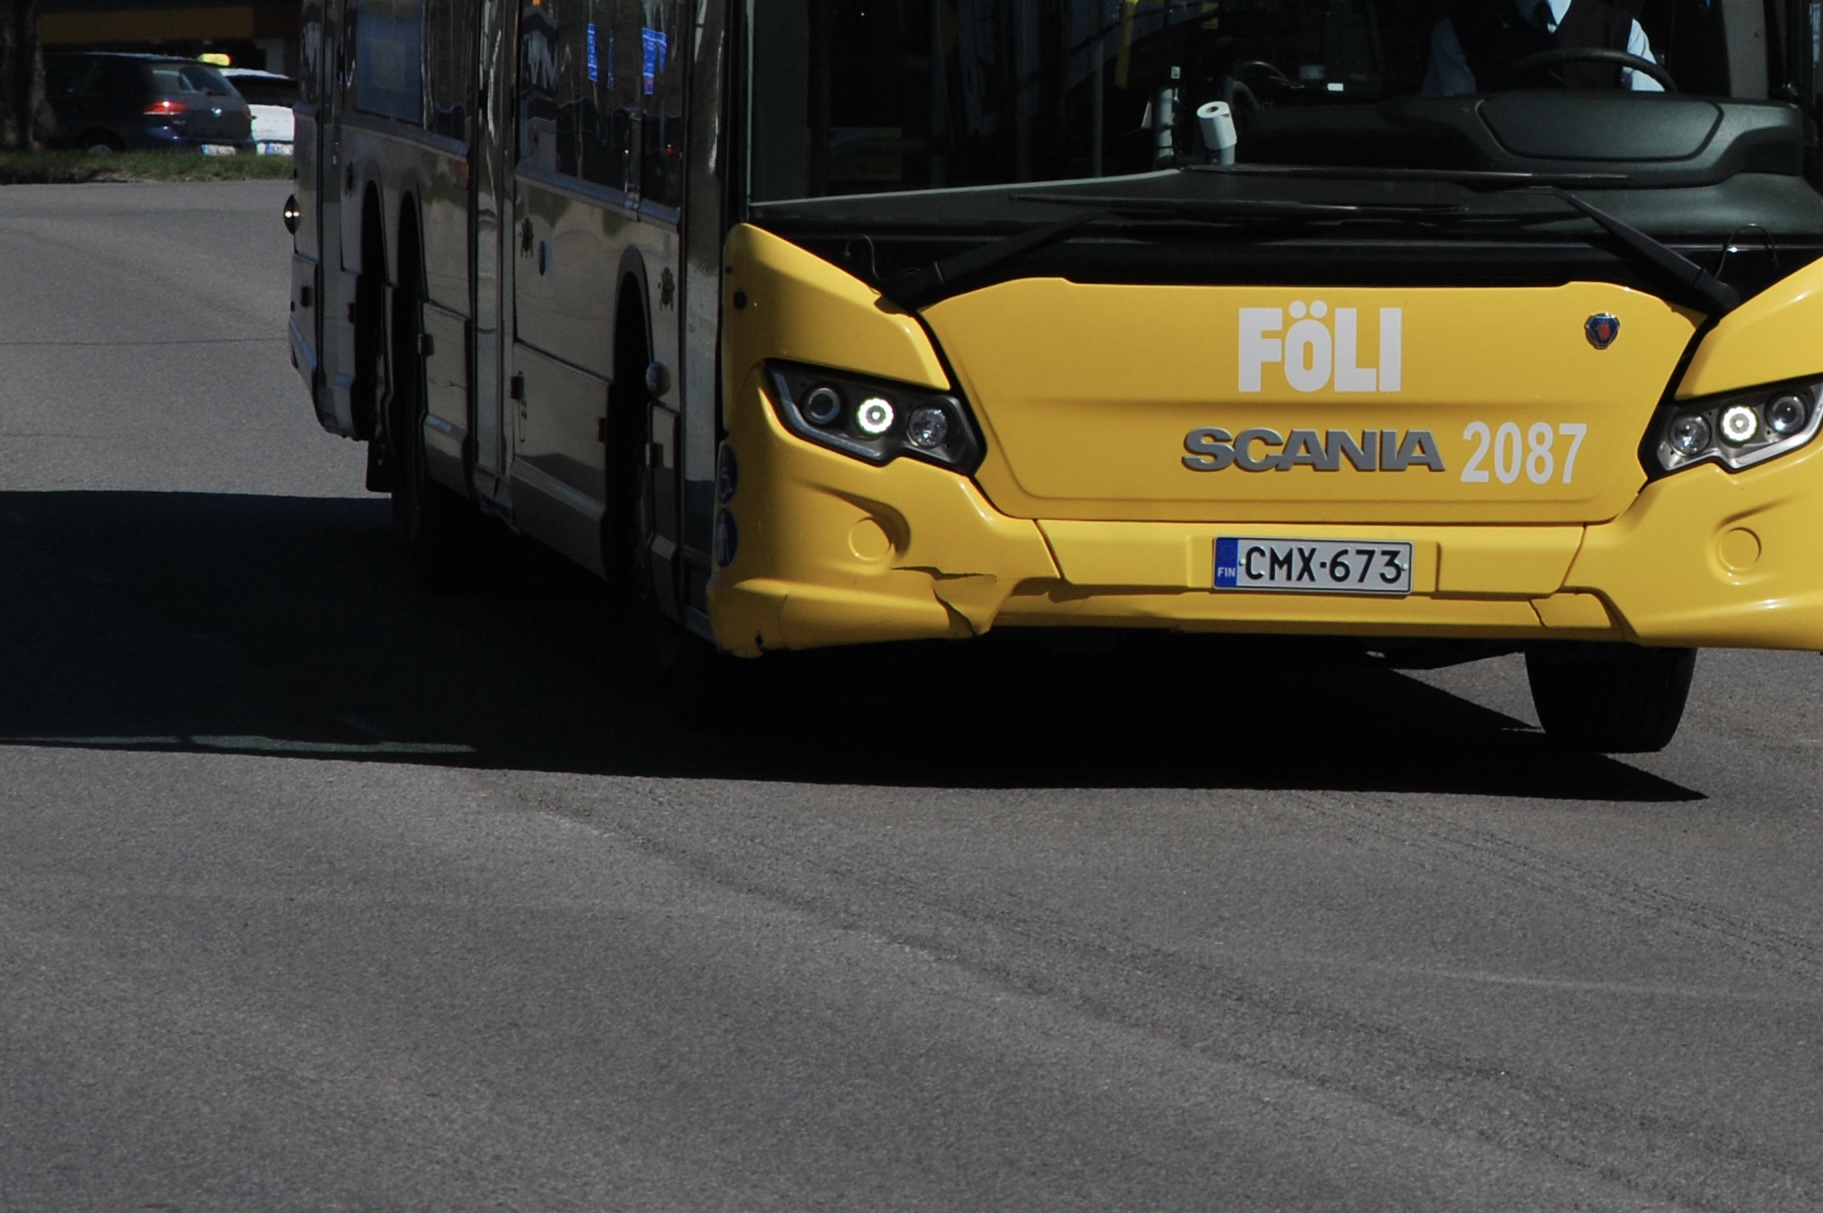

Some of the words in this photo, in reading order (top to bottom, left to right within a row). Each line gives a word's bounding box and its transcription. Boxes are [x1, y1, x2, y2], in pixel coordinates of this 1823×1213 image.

[1238, 300, 1402, 392] FÖLI
[1182, 427, 1446, 472] SCANIA
[1460, 420, 1588, 485] 2087
[1216, 566, 1236, 579] FIN
[1244, 546, 1403, 583] CMX-673
